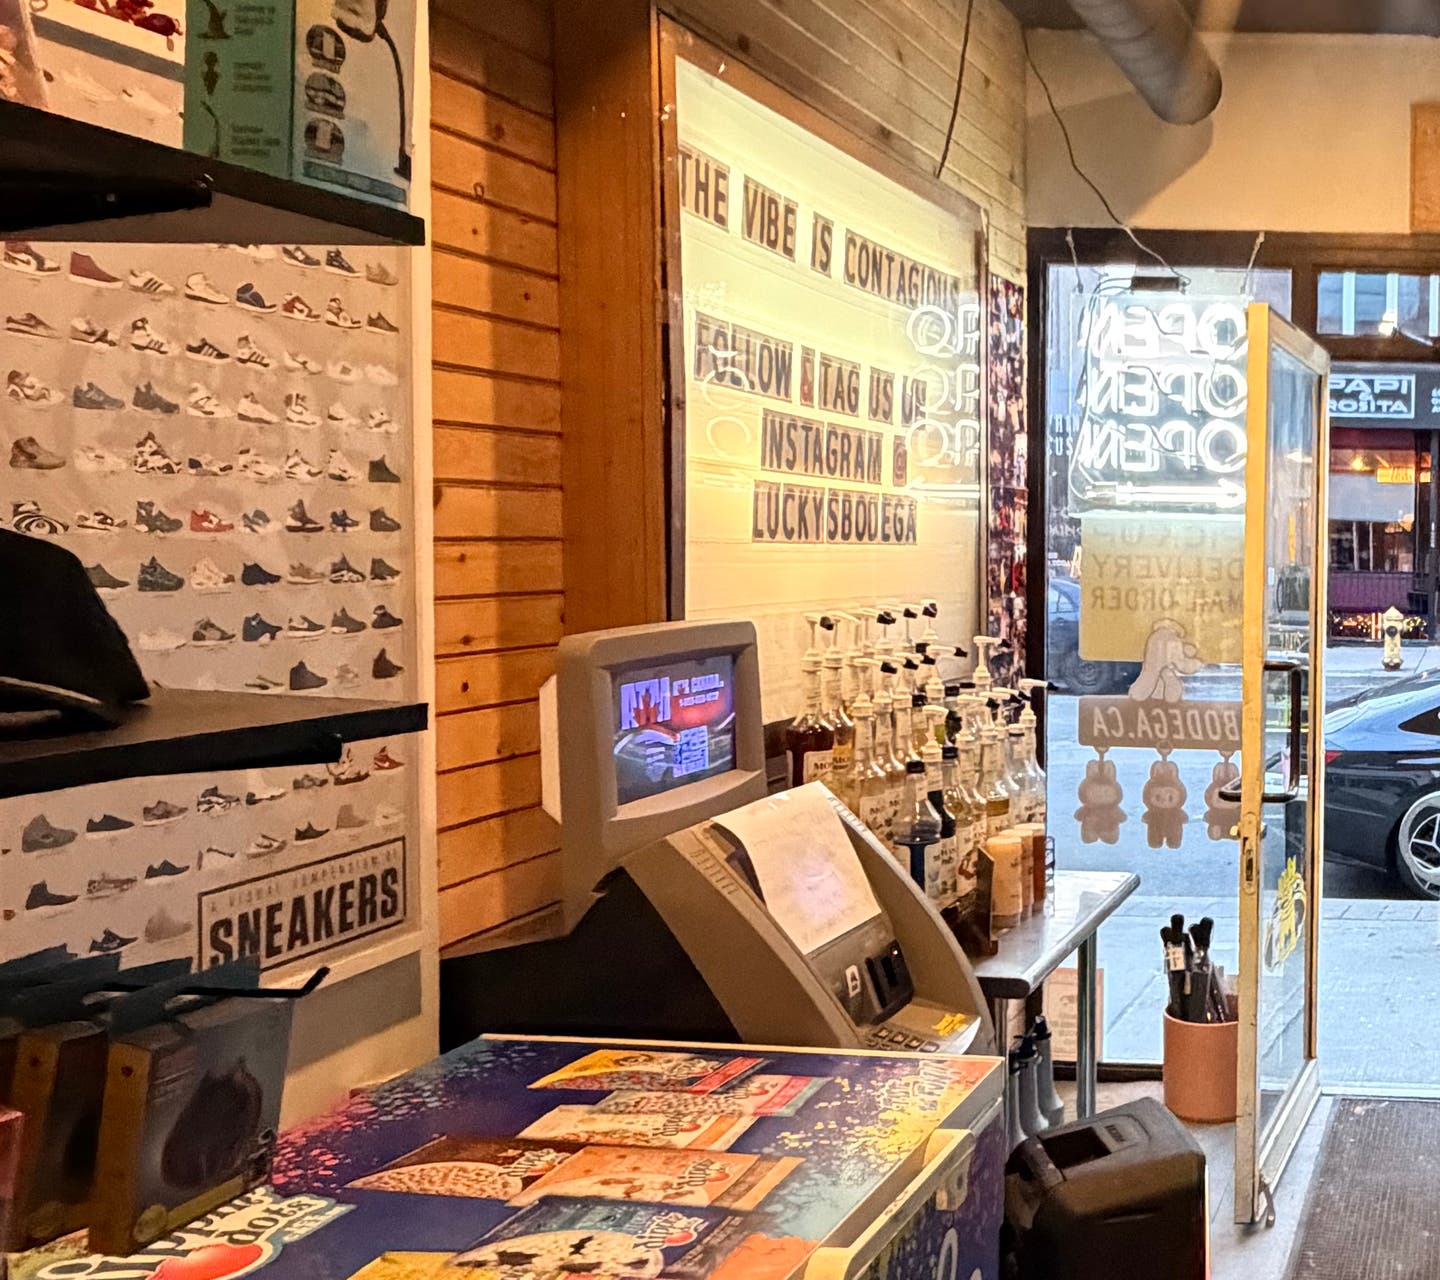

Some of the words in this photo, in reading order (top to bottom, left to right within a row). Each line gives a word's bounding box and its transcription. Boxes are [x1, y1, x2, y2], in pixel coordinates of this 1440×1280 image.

[680, 152, 728, 226] THE
[744, 188, 795, 256] VIBE
[812, 222, 832, 273] IS
[696, 323, 792, 398] FOLLOW
[821, 361, 859, 411] TAG
[871, 379, 893, 419] US
[763, 417, 881, 480] INSTAGRAM
[754, 488, 917, 543] LUCKYSBODEGA
[209, 866, 399, 968] SNEAKERS
